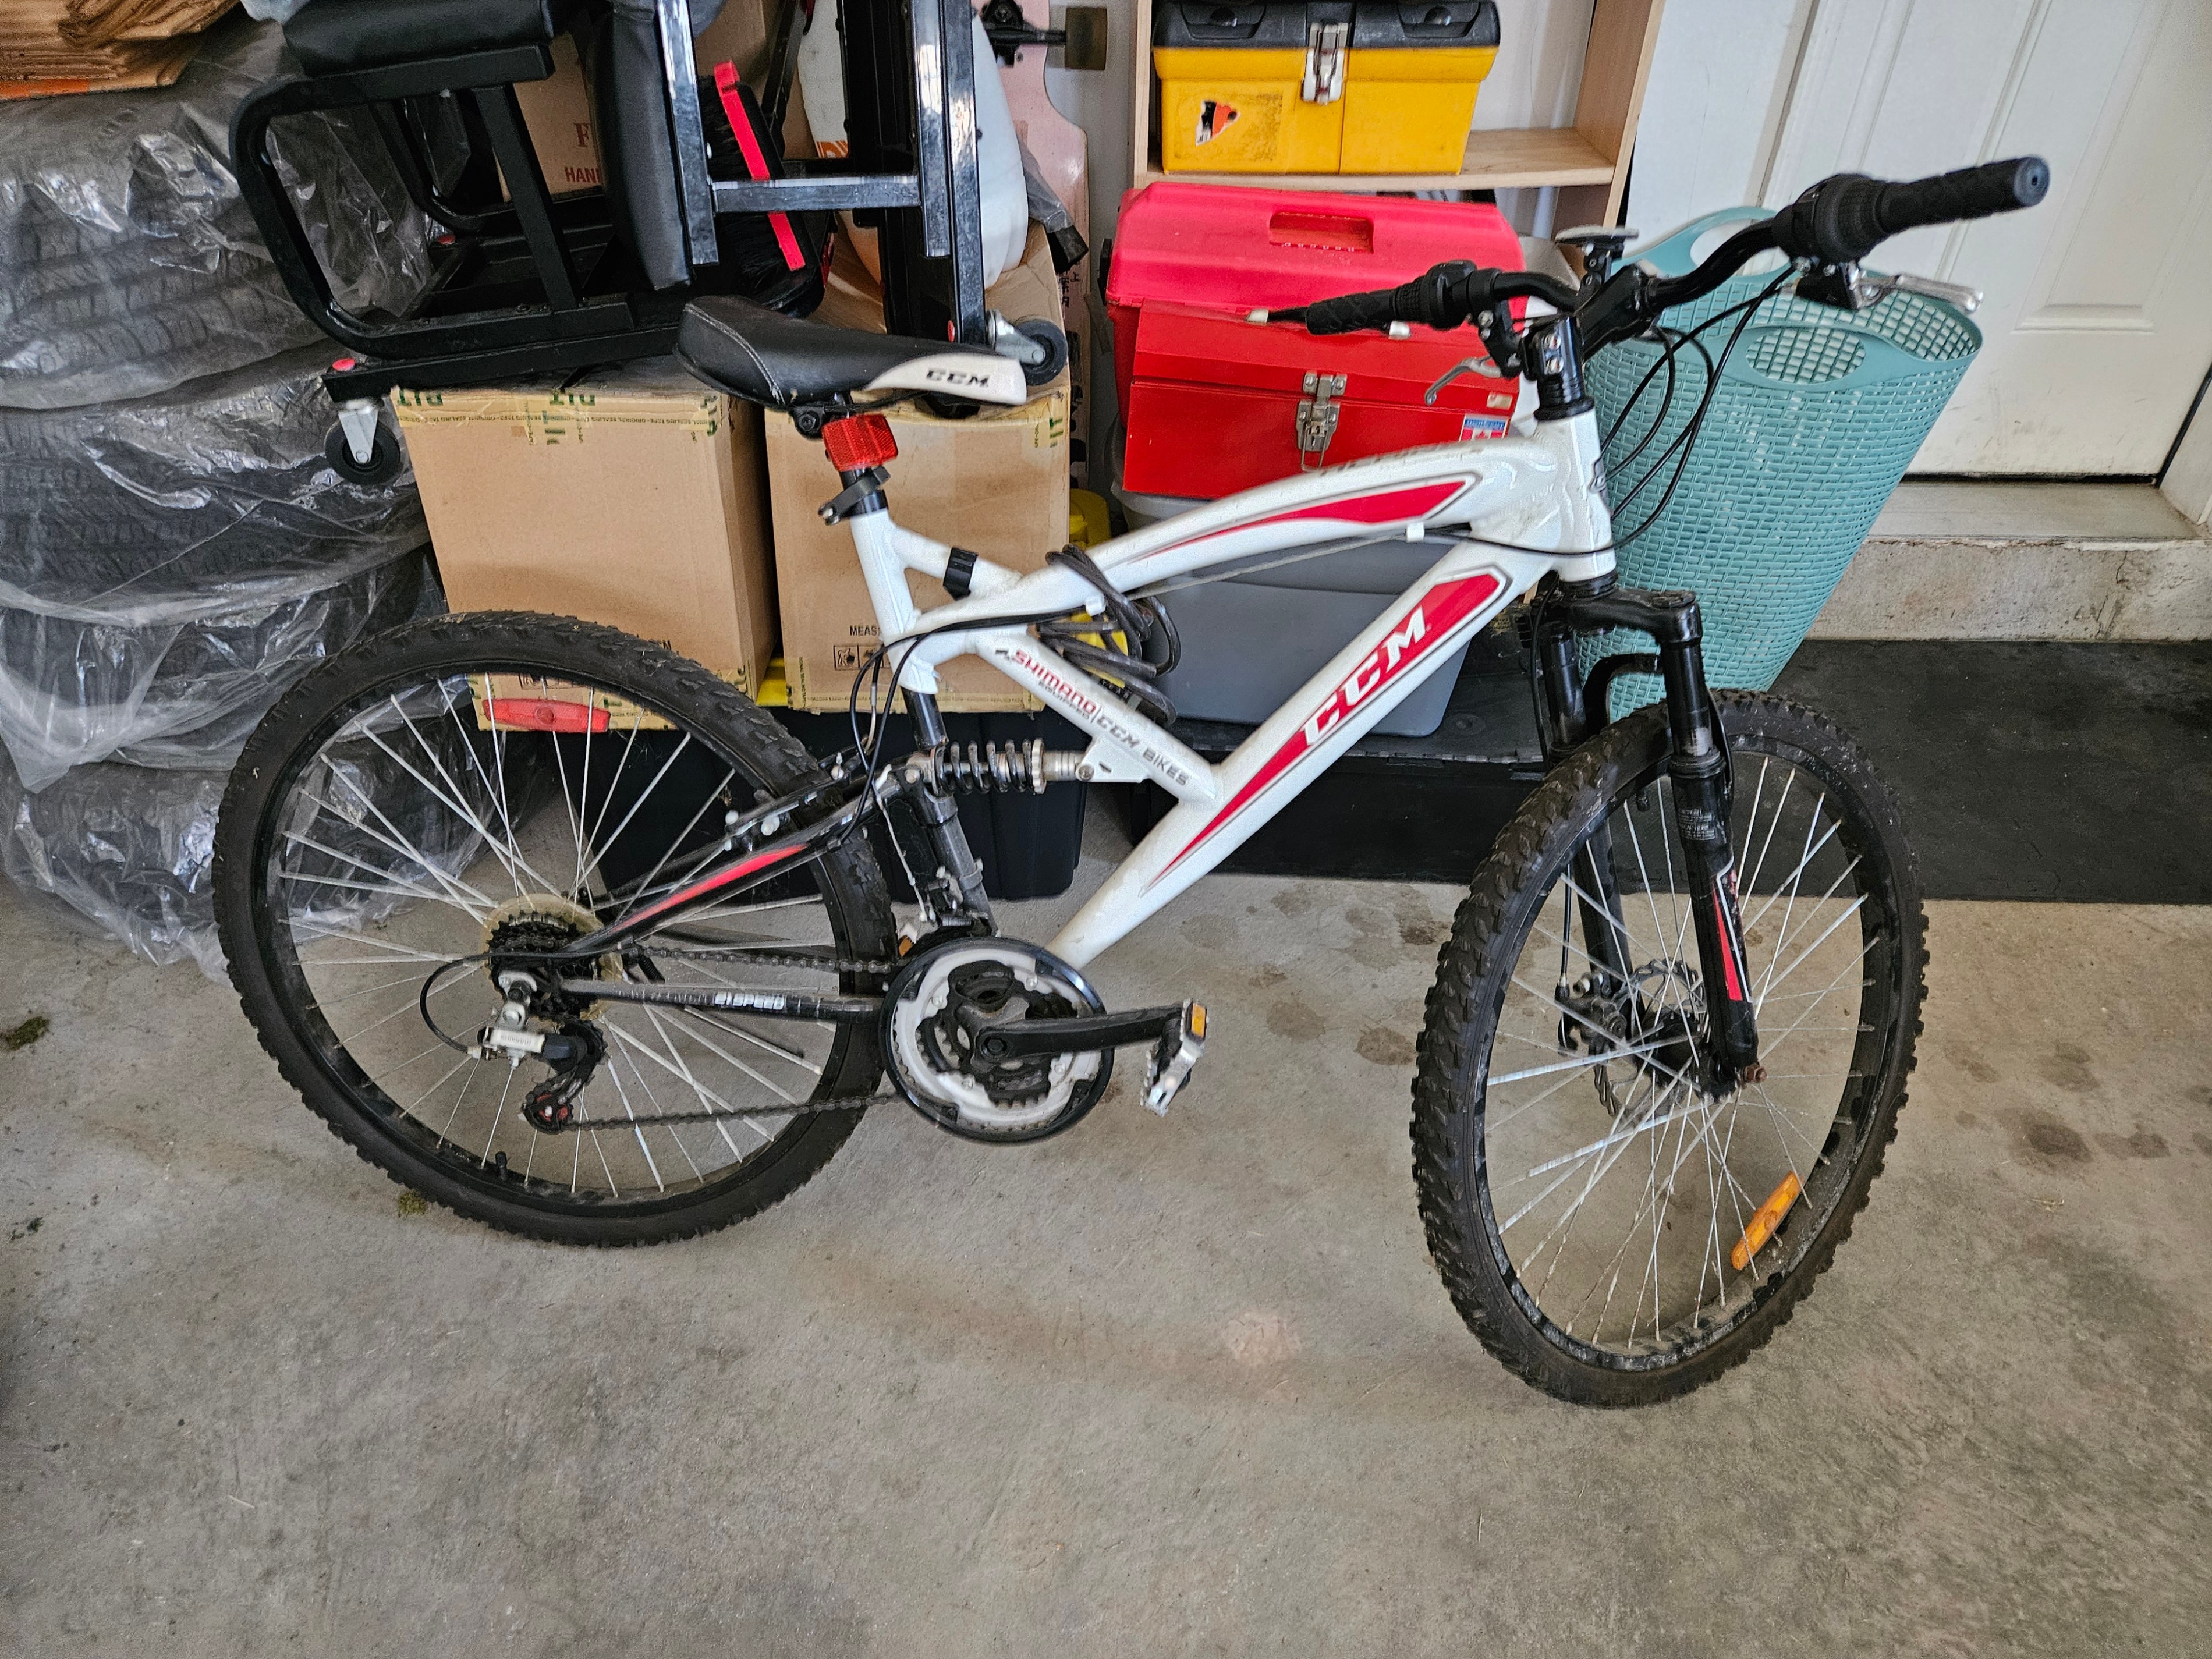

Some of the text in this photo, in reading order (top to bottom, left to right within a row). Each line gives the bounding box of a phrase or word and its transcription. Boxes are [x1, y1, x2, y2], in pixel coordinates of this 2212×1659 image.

[926, 368, 991, 388] CCM
[1013, 649, 1097, 714] SHIMANO
[1038, 680, 1090, 720] EQUIPPED
[1298, 605, 1426, 746] CCM
[1096, 714, 1189, 786] CCM BIKES
